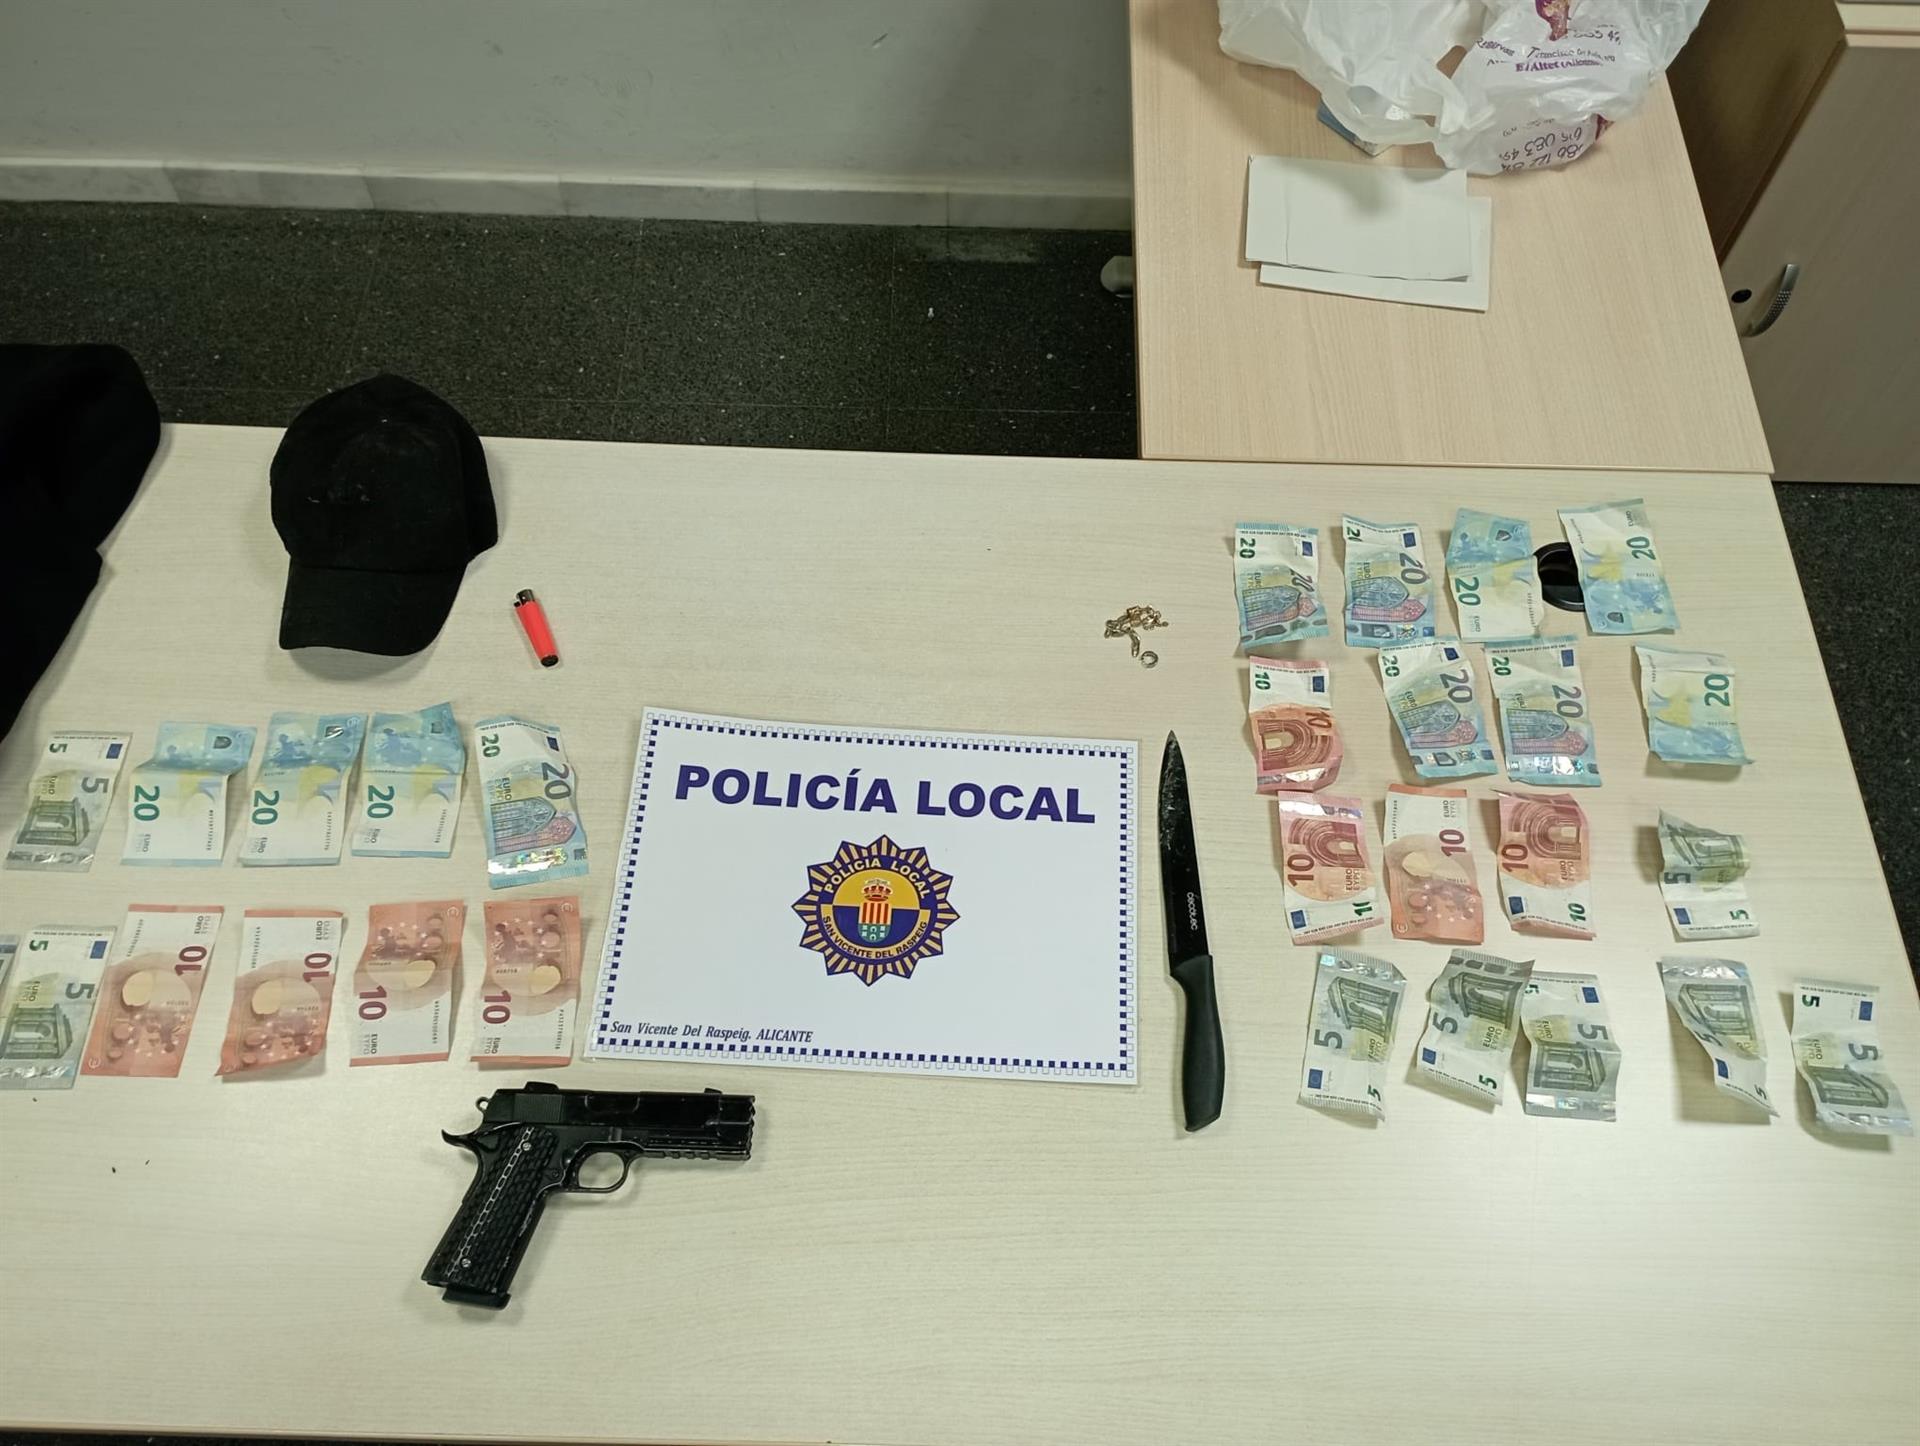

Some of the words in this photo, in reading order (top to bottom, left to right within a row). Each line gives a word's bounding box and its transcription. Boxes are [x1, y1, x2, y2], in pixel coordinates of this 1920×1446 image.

[1239, 537, 1257, 559] 20
[1626, 535, 1657, 562] 20
[1399, 552, 1430, 585] 20
[1455, 576, 1481, 607] 20
[1382, 655, 1401, 678] 20
[1491, 656, 1512, 676] 20
[1254, 671, 1271, 691] 10
[1439, 669, 1473, 704] 20
[1704, 673, 1731, 707] 20
[1551, 684, 1584, 719] 20
[1305, 711, 1332, 730] 10
[49, 743, 68, 754] 5
[481, 733, 500, 759] 20
[81, 776, 110, 794] 5
[541, 762, 572, 800] 20
[133, 785, 161, 822] 20
[366, 784, 395, 820] 20
[675, 763, 898, 815] POLICÍA
[917, 780, 1096, 825] LOCAL
[251, 790, 280, 826] 20
[1439, 828, 1467, 858] 10
[1501, 843, 1529, 873] 10
[824, 857, 881, 894] POLICIA
[890, 860, 931, 899] LOCAL
[1286, 853, 1315, 887] 10
[1345, 868, 1353, 891] EURO
[1560, 860, 1568, 881] EURO
[1664, 871, 1691, 885] 5
[1567, 903, 1586, 922] 10
[1729, 909, 1750, 921] 5
[315, 920, 323, 941] EURO
[822, 915, 835, 937] SAN
[833, 937, 873, 959] VICENTE
[875, 949, 894, 959] DEL
[895, 921, 928, 956] RASPEIG
[28, 939, 49, 952] 5
[174, 945, 208, 977] 10
[302, 952, 332, 983] 10
[65, 982, 95, 1000] 5
[1802, 994, 1820, 1008] 5
[358, 985, 387, 1021] 10
[482, 990, 512, 1025] 10
[610, 1020, 632, 1034] San
[636, 1022, 678, 1036] Vicente
[682, 1025, 702, 1037] Del
[706, 1026, 752, 1043] Raspeig.
[756, 1028, 815, 1043] ALICANTE
[1432, 1011, 1459, 1034] 5
[1576, 1023, 1609, 1041] 5
[370, 1033, 379, 1055] EURO
[491, 1036, 500, 1055] EURO
[1313, 1029, 1343, 1050] 5
[1483, 1026, 1495, 1048] EURO
[1848, 1042, 1879, 1061] 5
[1367, 1085, 1382, 1102] 5
[1478, 1074, 1498, 1090] 5
